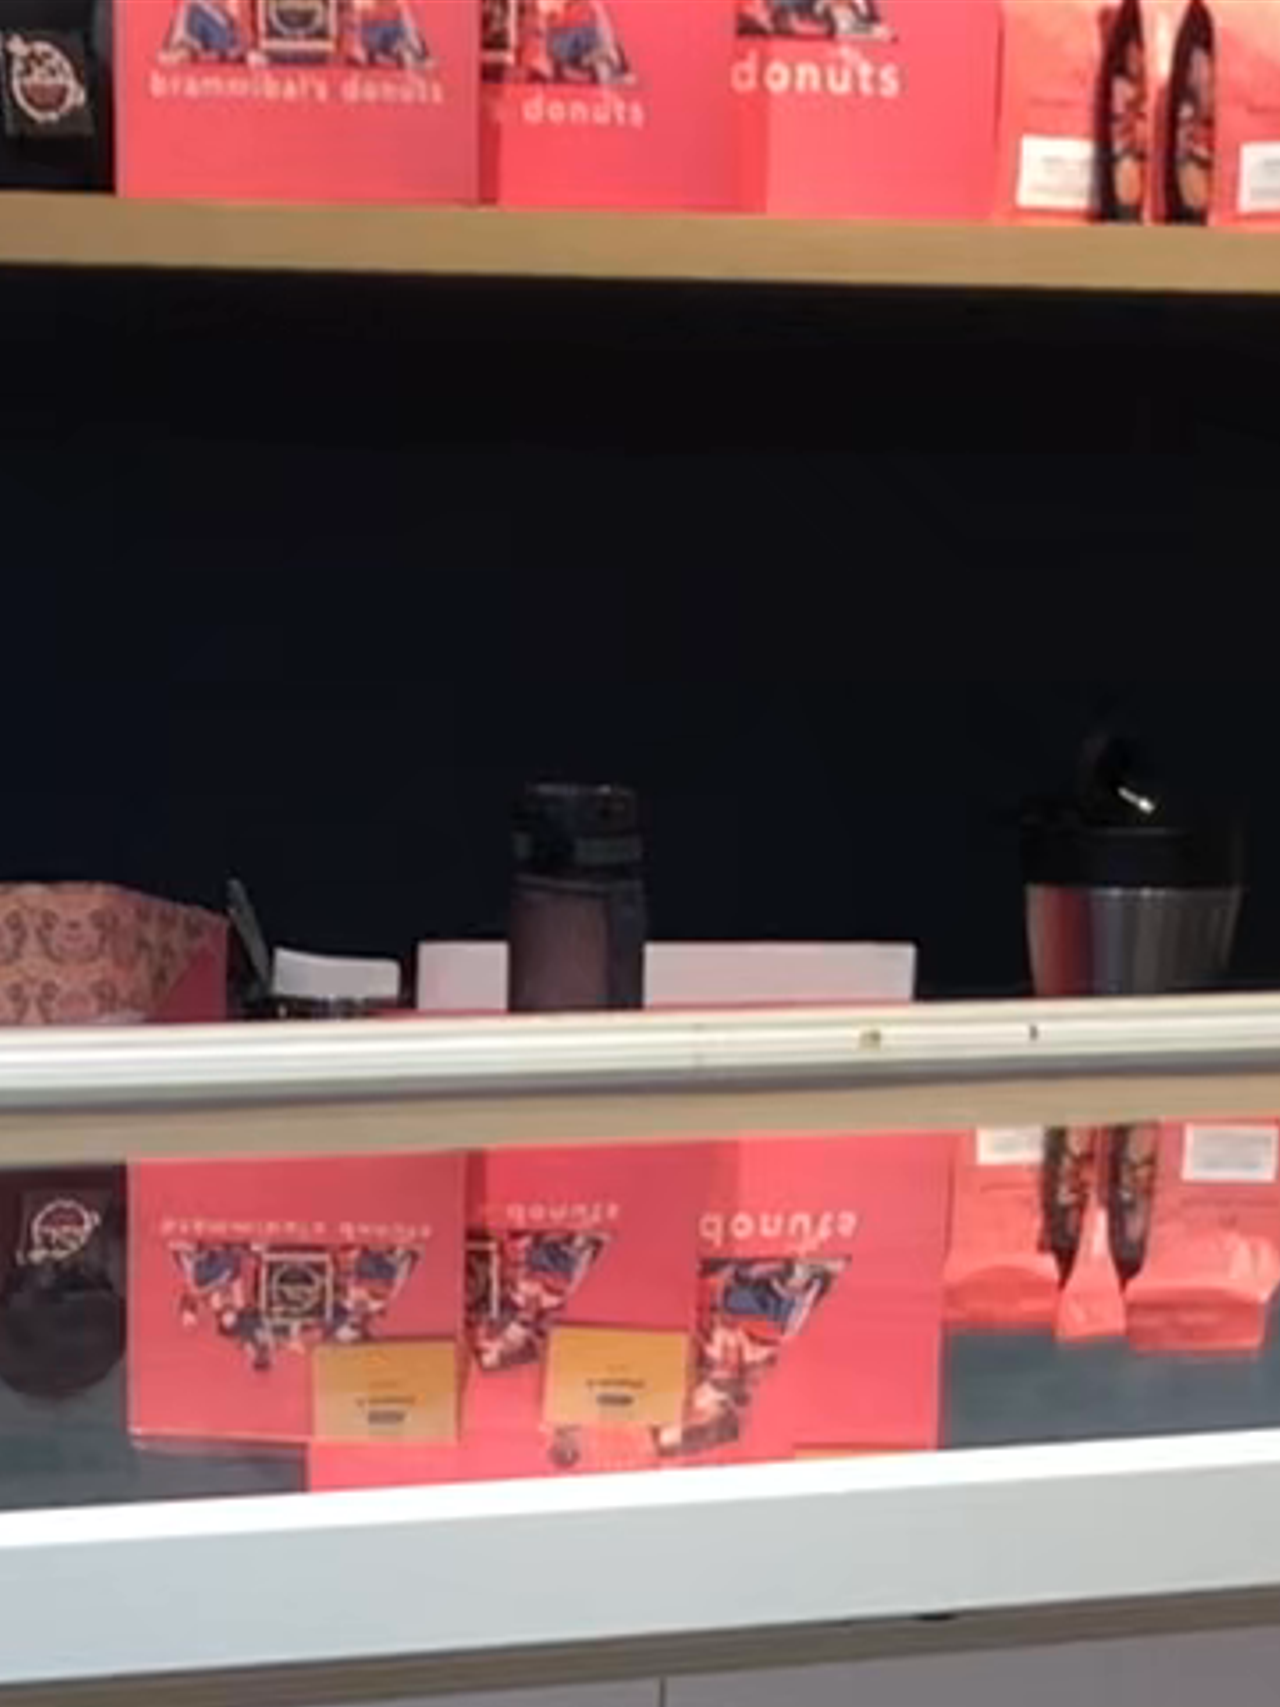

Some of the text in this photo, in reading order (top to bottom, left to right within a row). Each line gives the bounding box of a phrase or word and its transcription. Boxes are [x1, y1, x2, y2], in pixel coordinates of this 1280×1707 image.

[340, 70, 443, 104] donuts
[730, 47, 900, 97] donuts
[522, 92, 645, 129] donuts
